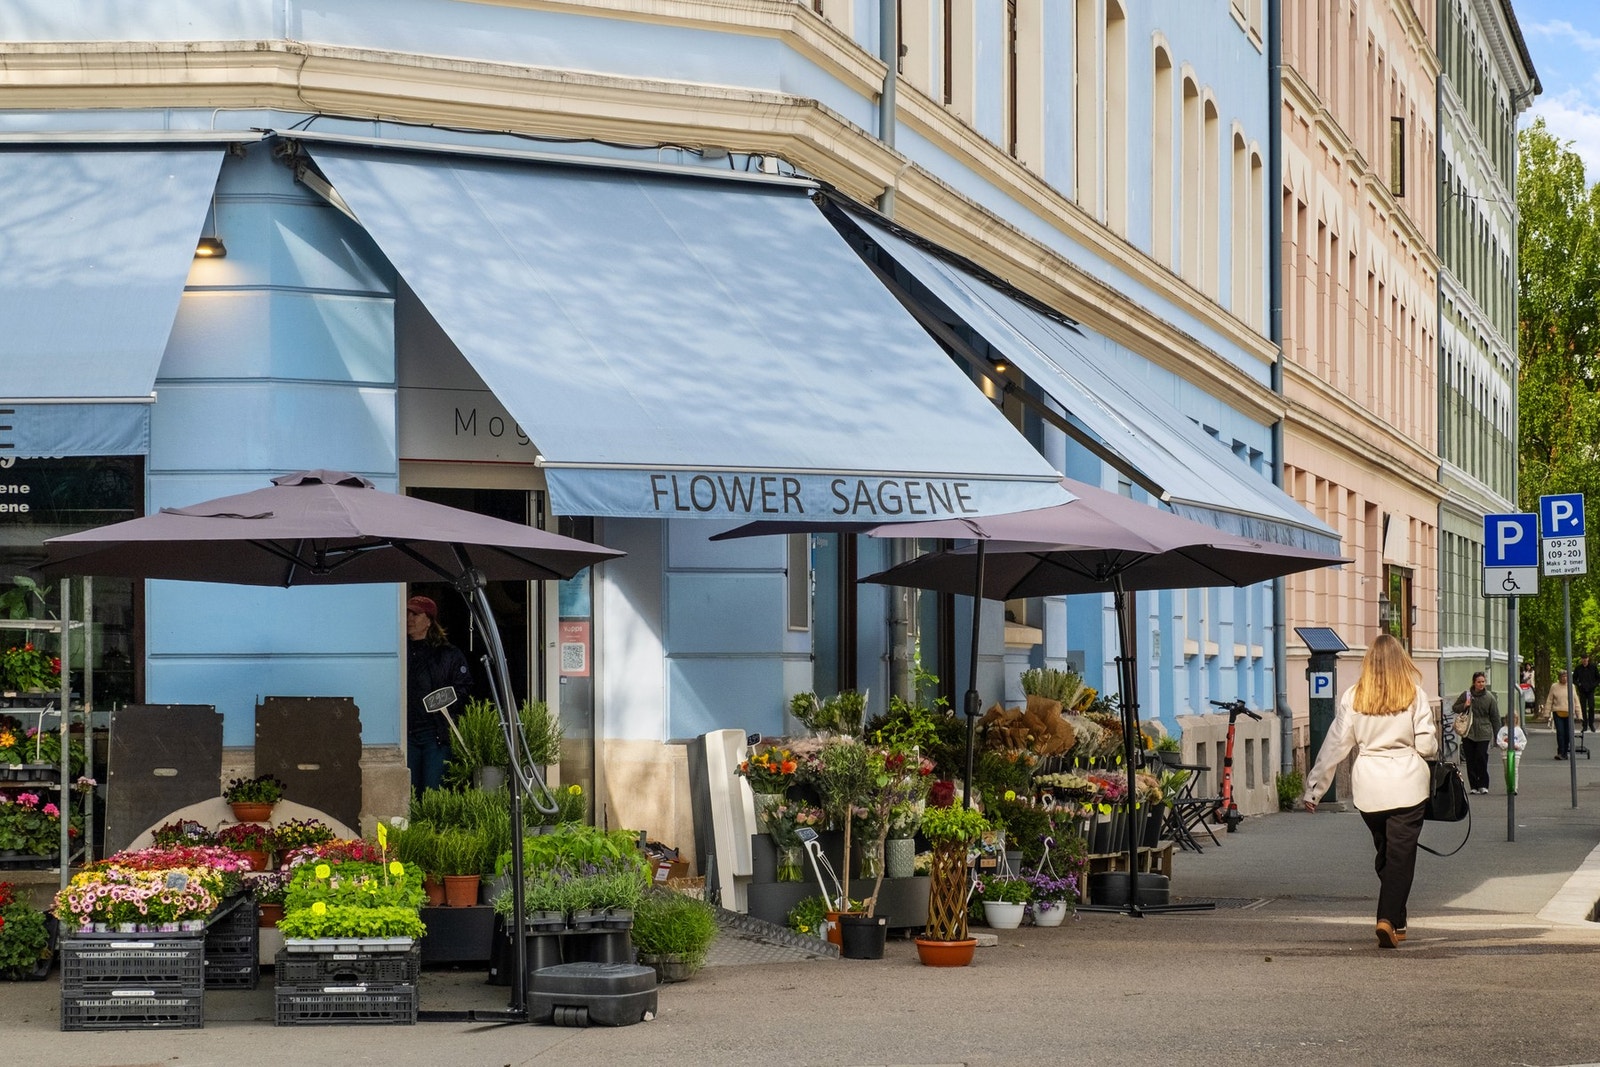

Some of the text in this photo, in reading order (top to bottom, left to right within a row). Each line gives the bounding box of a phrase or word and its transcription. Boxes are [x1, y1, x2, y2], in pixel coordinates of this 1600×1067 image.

[649, 474, 979, 515] FLOWER SAGENE
[1551, 500, 1574, 533] P
[1497, 520, 1524, 560] P
[1564, 566, 1580, 574] avgift
[1315, 675, 1330, 695] P
